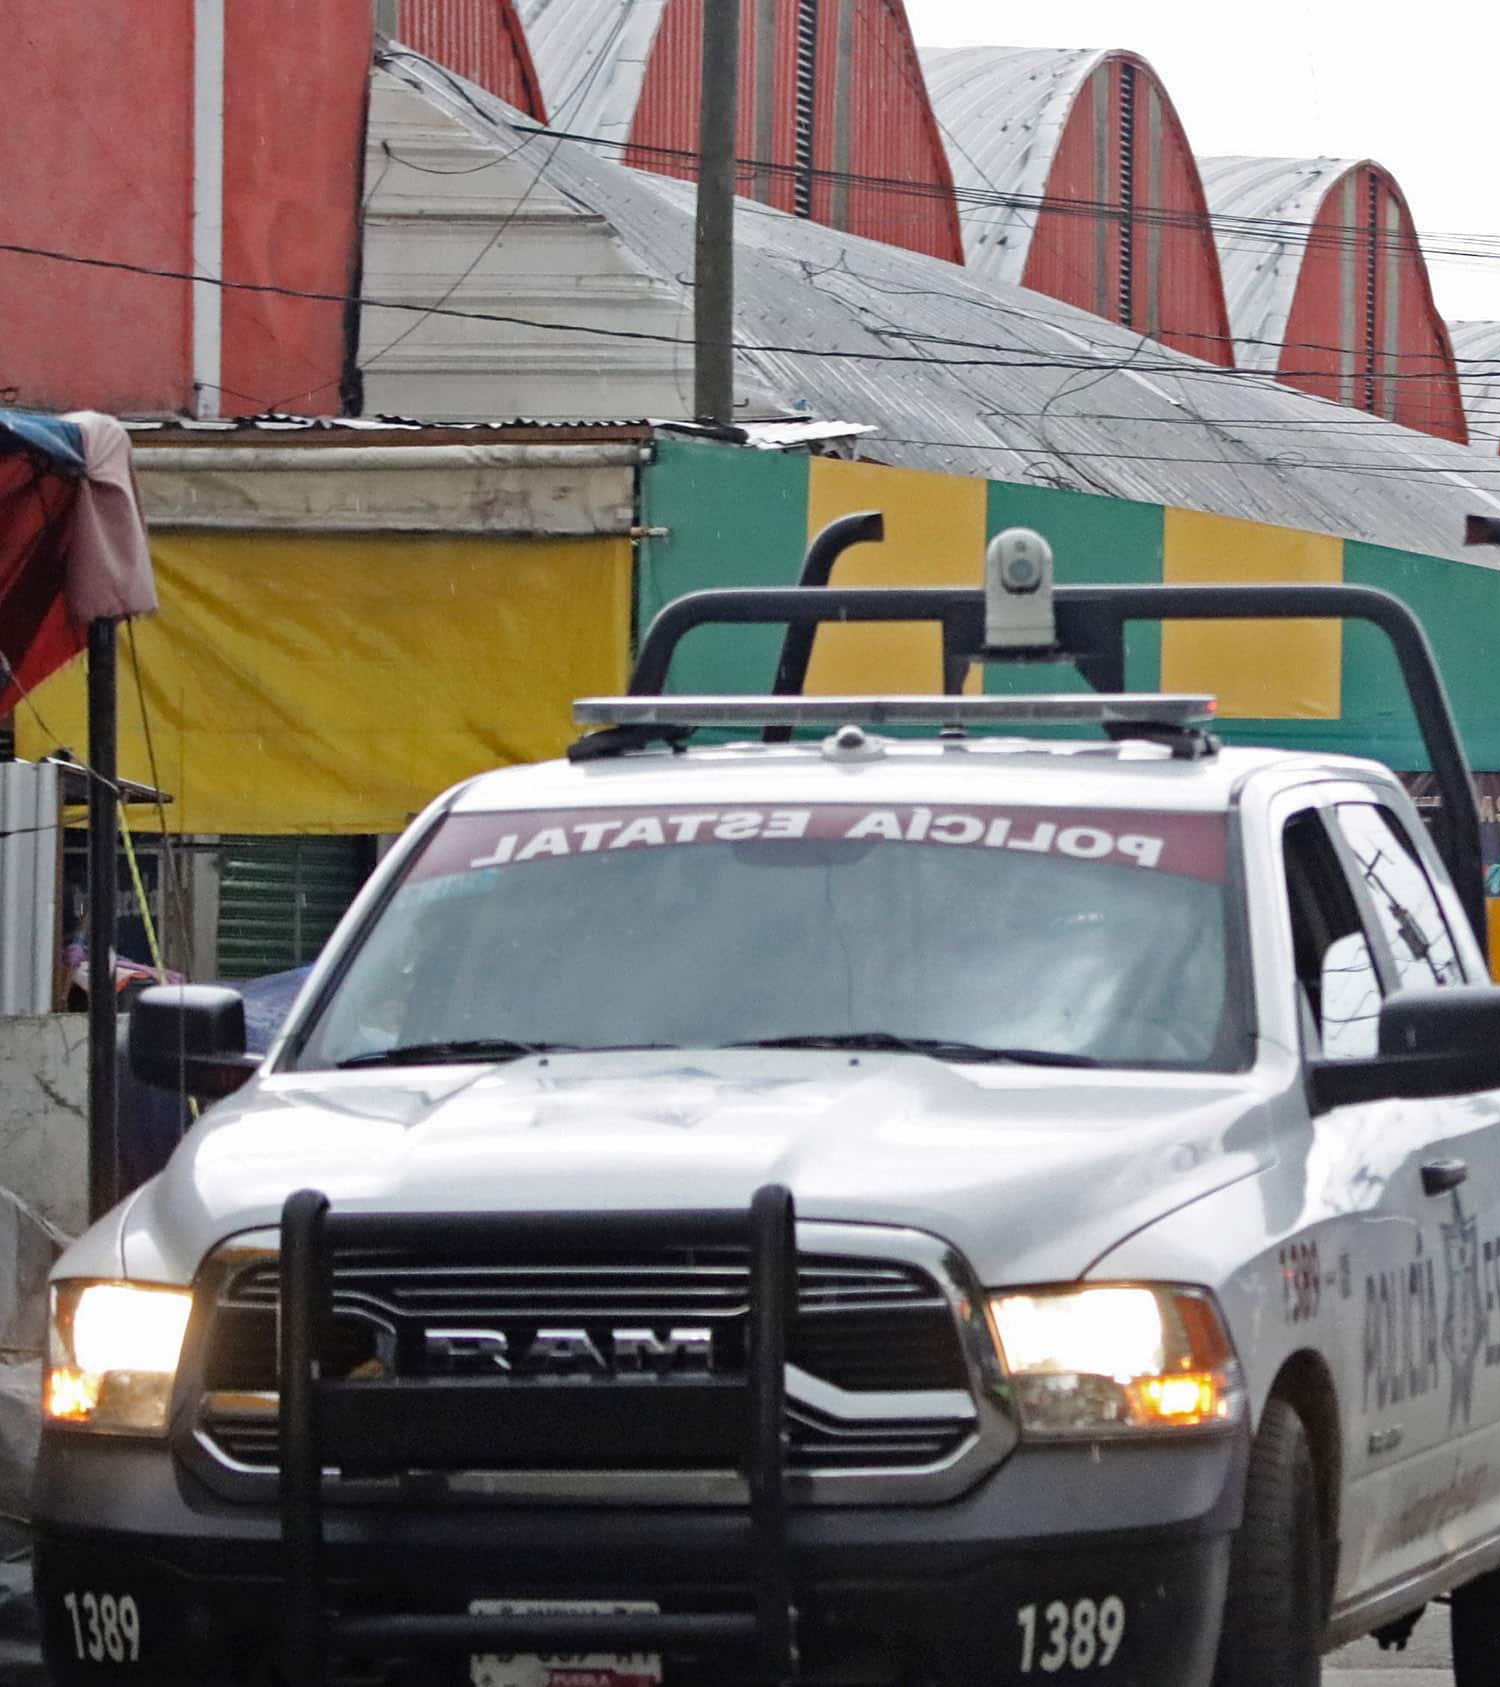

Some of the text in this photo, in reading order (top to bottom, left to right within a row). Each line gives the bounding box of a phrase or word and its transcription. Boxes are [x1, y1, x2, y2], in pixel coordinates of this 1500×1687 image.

[424, 1328, 712, 1372] RAM
[63, 1590, 141, 1663] 1389
[1016, 1594, 1126, 1673] 1389
